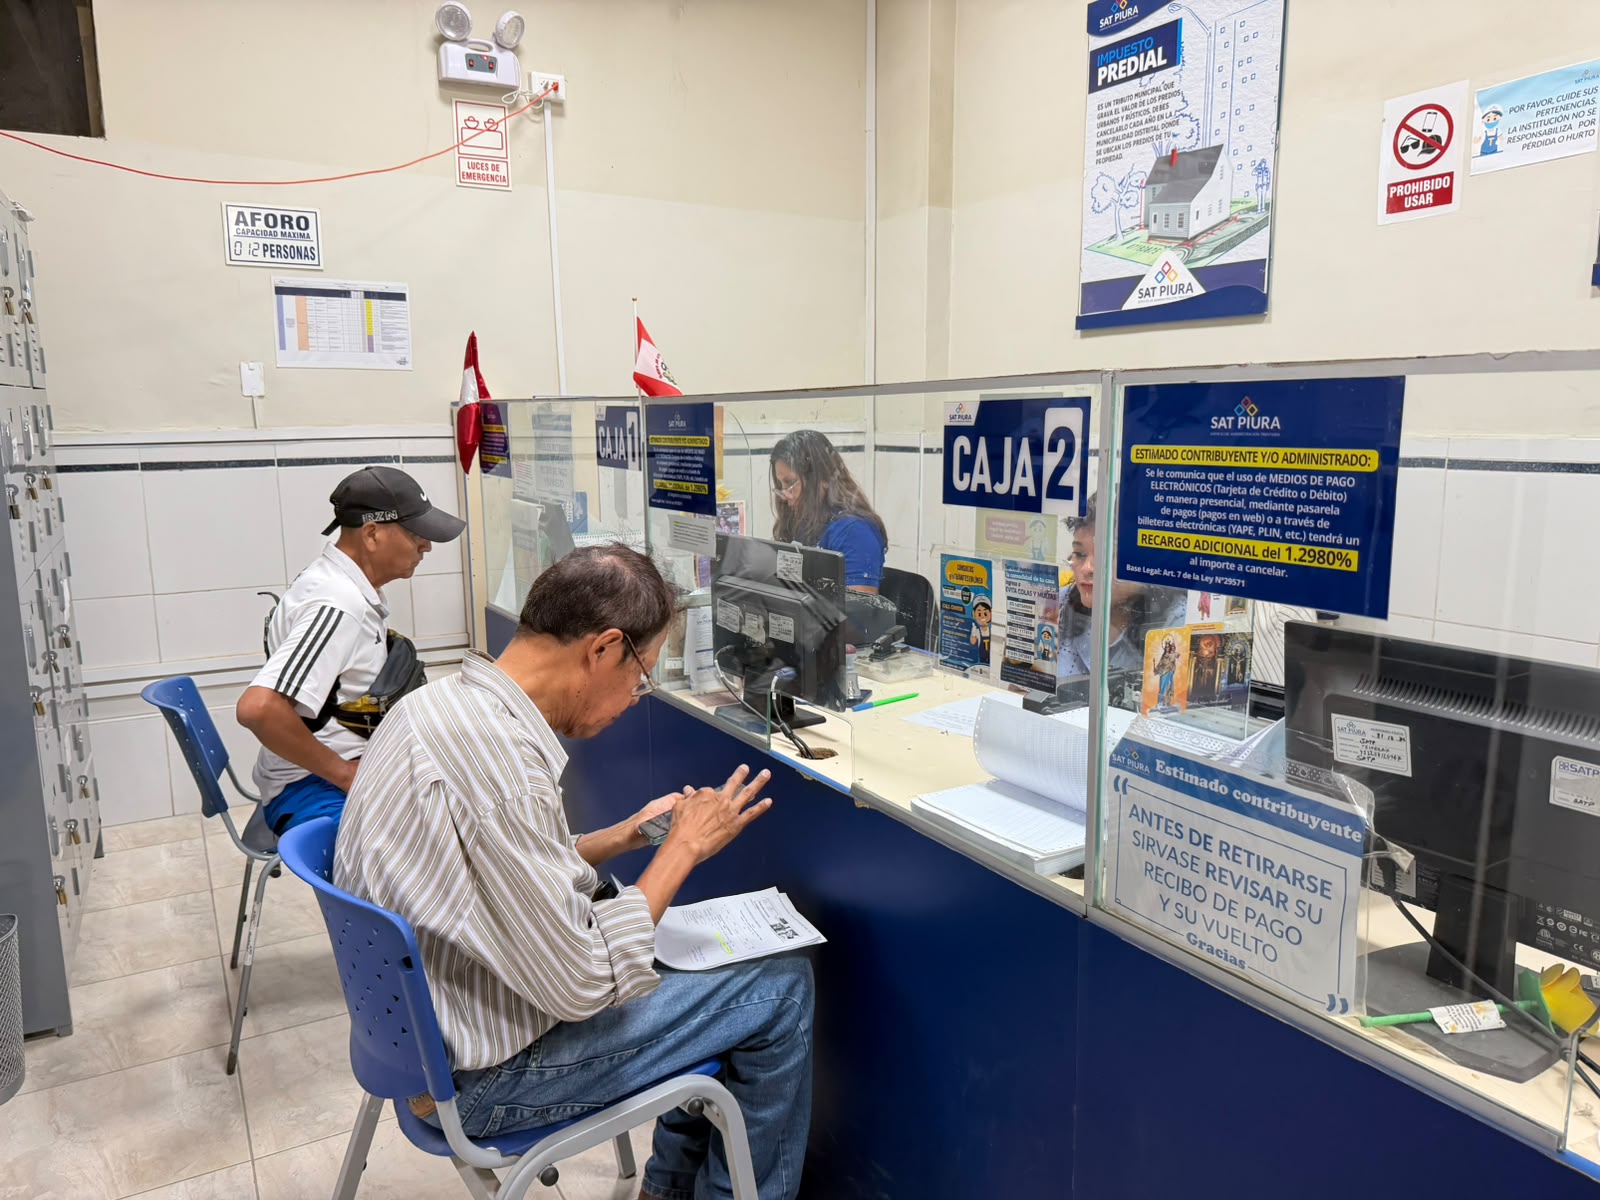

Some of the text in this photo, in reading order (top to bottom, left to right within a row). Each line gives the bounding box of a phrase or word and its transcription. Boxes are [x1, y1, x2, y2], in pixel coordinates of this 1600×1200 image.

[1100, 6, 1138, 28] SAT PIURA
[1098, 37, 1154, 67] IMPUESTO
[1098, 46, 1167, 86] PREDIAL
[1097, 112, 1113, 120] GRAVA
[1122, 102, 1137, 113] VALOR
[1147, 97, 1157, 105] LOS
[1158, 89, 1180, 102] PREDIOS
[1113, 95, 1133, 106] TRIBUTO
[1134, 86, 1162, 99] MUNICIPAL
[1163, 82, 1175, 90] QUE
[1509, 104, 1527, 114] POR
[1556, 90, 1581, 103] CUIDE
[1582, 86, 1599, 96] SUS
[1097, 118, 1120, 129] URBANOS
[1152, 102, 1169, 112] DEBES
[1519, 114, 1569, 131] INSTITUCIÓN
[1572, 110, 1585, 119] NO
[1587, 107, 1597, 115] SE
[1096, 119, 1179, 147] MUNICIPALIDAD DISTRITAL DONDE
[1097, 124, 1128, 138] CANCELARLO
[1129, 120, 1143, 128] CADA
[1507, 118, 1596, 144] RESPONSABILIZA POR
[1522, 129, 1595, 151] PÉRDIDA O HURTO
[1103, 144, 1120, 154] UBICAN
[1122, 141, 1132, 149] LOS
[1133, 134, 1154, 146] PREDIOS
[462, 171, 506, 183] EMERGENCIA
[467, 161, 500, 172] LUCES DE
[1389, 176, 1450, 198] PROHIBIDO
[1404, 192, 1433, 208] USAR
[235, 211, 310, 231] AFORO
[236, 228, 311, 239] CAPACIDAD MAXIMA
[263, 243, 316, 260] PERSONAS
[1138, 282, 1194, 299] SAT PIURA
[1210, 416, 1280, 429] SAT PIURA
[599, 421, 636, 463] CAJA 1
[953, 426, 1076, 500] CAJA 2
[1135, 449, 1371, 467] ESTIMADO CONTRIBUYENTE Y/O ADMINISTRADO:
[1145, 468, 1355, 487] Se le comunica que el uso de MEDIOS DE PAGO
[1151, 480, 1212, 493] ELECTRÓNICOS
[1213, 484, 1247, 496] (Tarjeta
[1249, 486, 1260, 496] de
[1263, 487, 1298, 498] Crédito
[1310, 489, 1347, 503] Débito)
[1154, 493, 1340, 515] de manera presencial, mediante pasarela
[1161, 506, 1171, 515] de
[1172, 508, 1197, 519] pagos
[1198, 509, 1226, 521] (pagos
[1229, 513, 1240, 521] en
[1242, 513, 1265, 525] web)
[1284, 517, 1314, 528] través
[1317, 518, 1330, 529] de
[1138, 516, 1360, 546] billeteras electrónicas (YAPE, PLIN, etc.) tendrá un
[1141, 534, 1352, 568] RECARGO ADICIONAL del 1.2980%
[1126, 564, 1141, 573] Base
[1142, 566, 1162, 576] Legal:
[1183, 572, 1191, 580] de
[1201, 574, 1213, 584] Ley
[1190, 557, 1288, 578] al importe a cancelar.
[1112, 753, 1150, 774] SAT PIURA
[1155, 759, 1362, 842] Estimado contribuyente
[1128, 803, 1332, 900] ANTES DE RETIRARSE
[1132, 830, 1323, 925] SIRVASE REVISAR SU
[1144, 861, 1302, 945] RECIBO DE PAGO
[1159, 894, 1278, 962] Y SU VUELTO
[1186, 932, 1246, 970] Gracias
